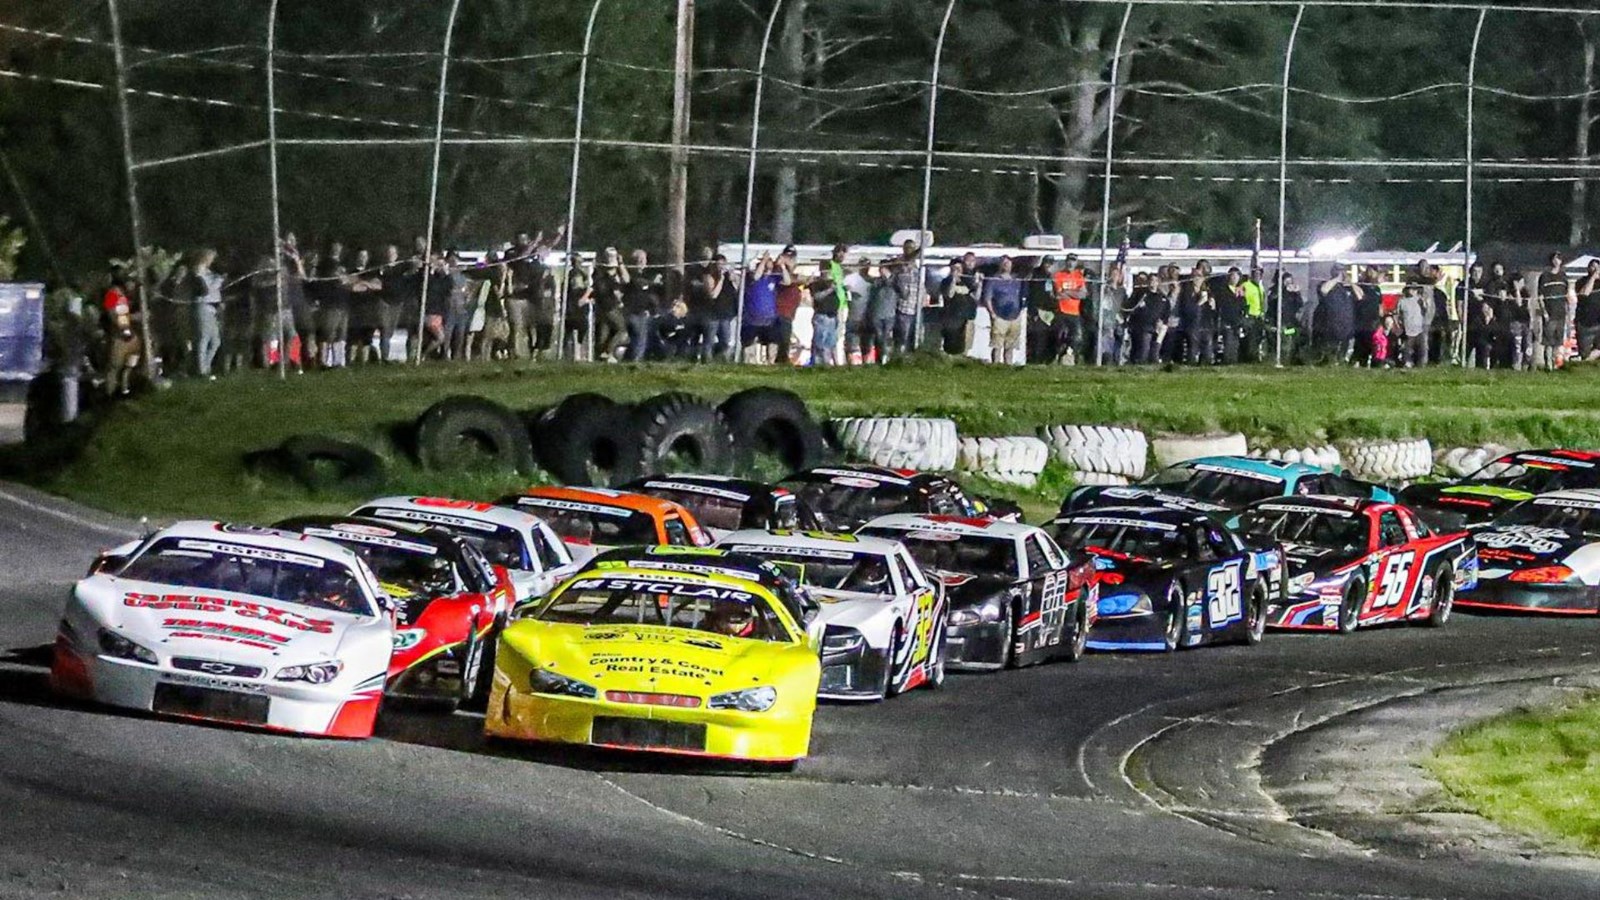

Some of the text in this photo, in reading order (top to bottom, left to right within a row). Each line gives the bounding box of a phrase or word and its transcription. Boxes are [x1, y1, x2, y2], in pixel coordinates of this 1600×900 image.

[547, 501, 601, 512] GSPSS
[407, 512, 465, 524] GSPSS
[1099, 518, 1148, 526] GSPSS
[339, 533, 402, 546] GSPSS
[216, 545, 287, 559] GSPSS
[762, 546, 821, 556] GSPSS
[662, 563, 725, 574] GSPSS
[1373, 551, 1416, 608] 56
[607, 580, 752, 602] STCLAIR
[1208, 560, 1242, 628] 32
[124, 598, 226, 612] USED
[235, 609, 333, 634] CARS
[589, 657, 656, 665] Country
[678, 661, 724, 676] Coast
[606, 664, 705, 679] Real Estate
